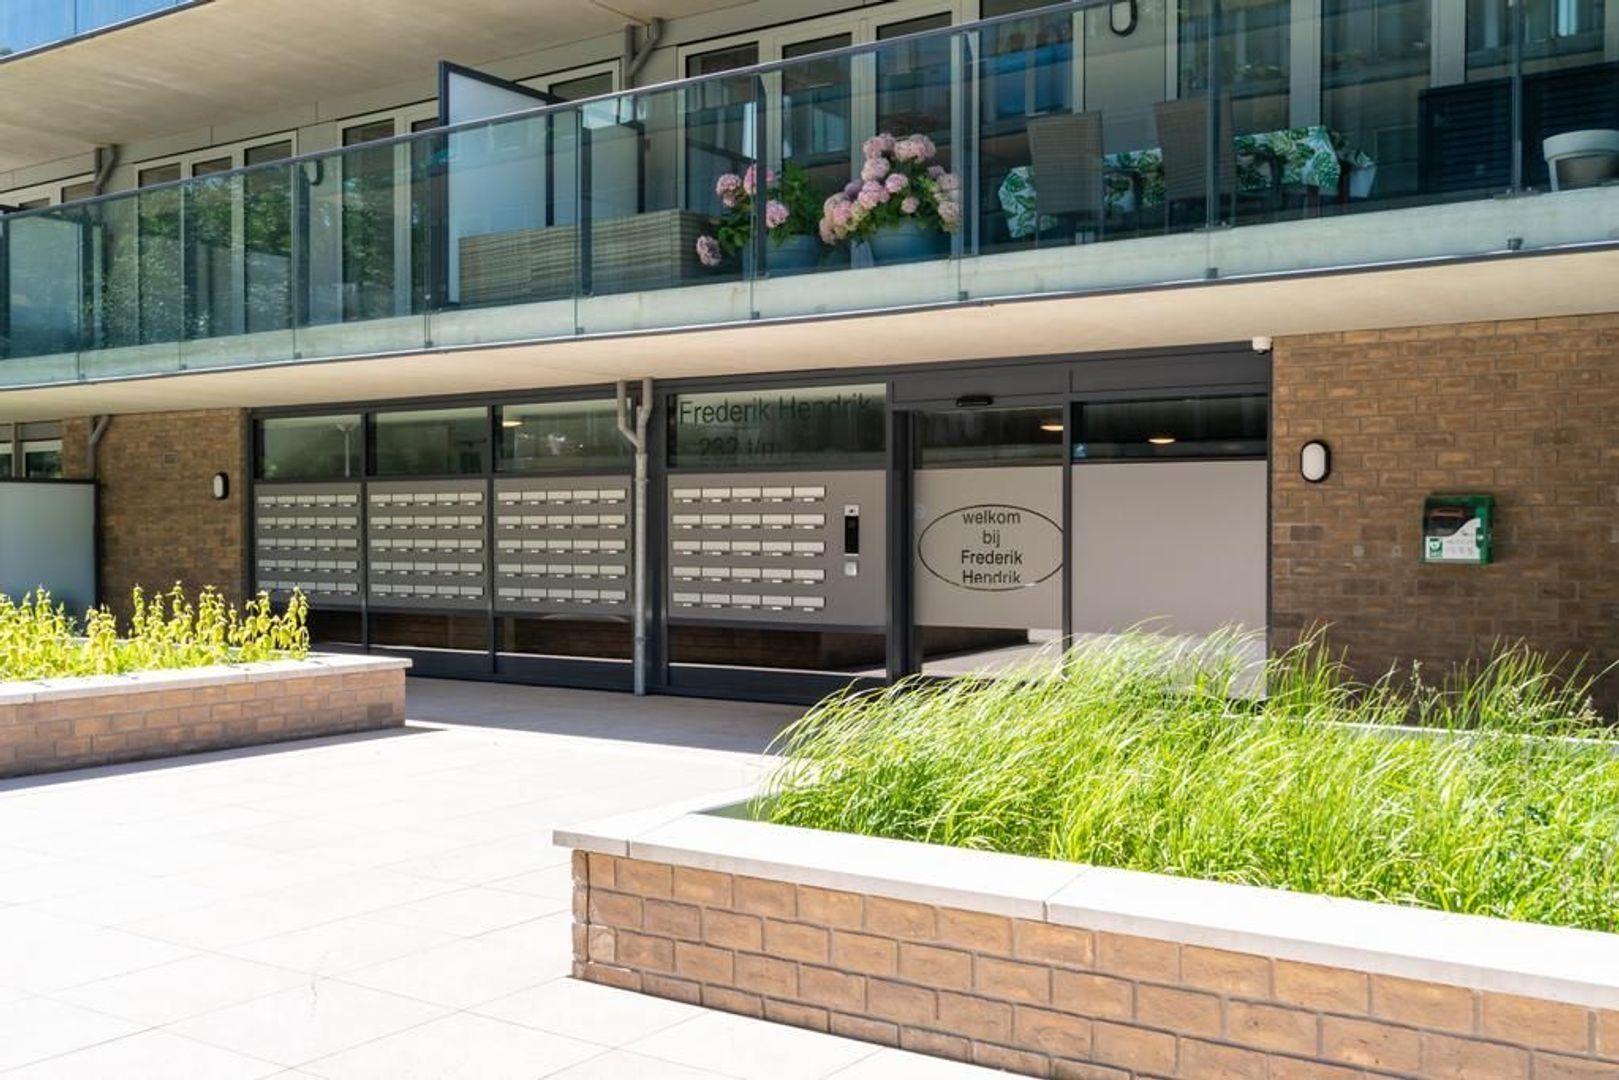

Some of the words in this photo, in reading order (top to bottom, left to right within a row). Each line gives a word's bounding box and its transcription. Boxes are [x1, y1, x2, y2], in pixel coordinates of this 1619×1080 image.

[679, 397, 770, 425] Frederik
[779, 392, 872, 421] Hendrik
[962, 510, 1021, 524] welkom
[982, 530, 1001, 548] bij
[961, 549, 1023, 565] Frederik
[962, 569, 1021, 583] Hendrik
